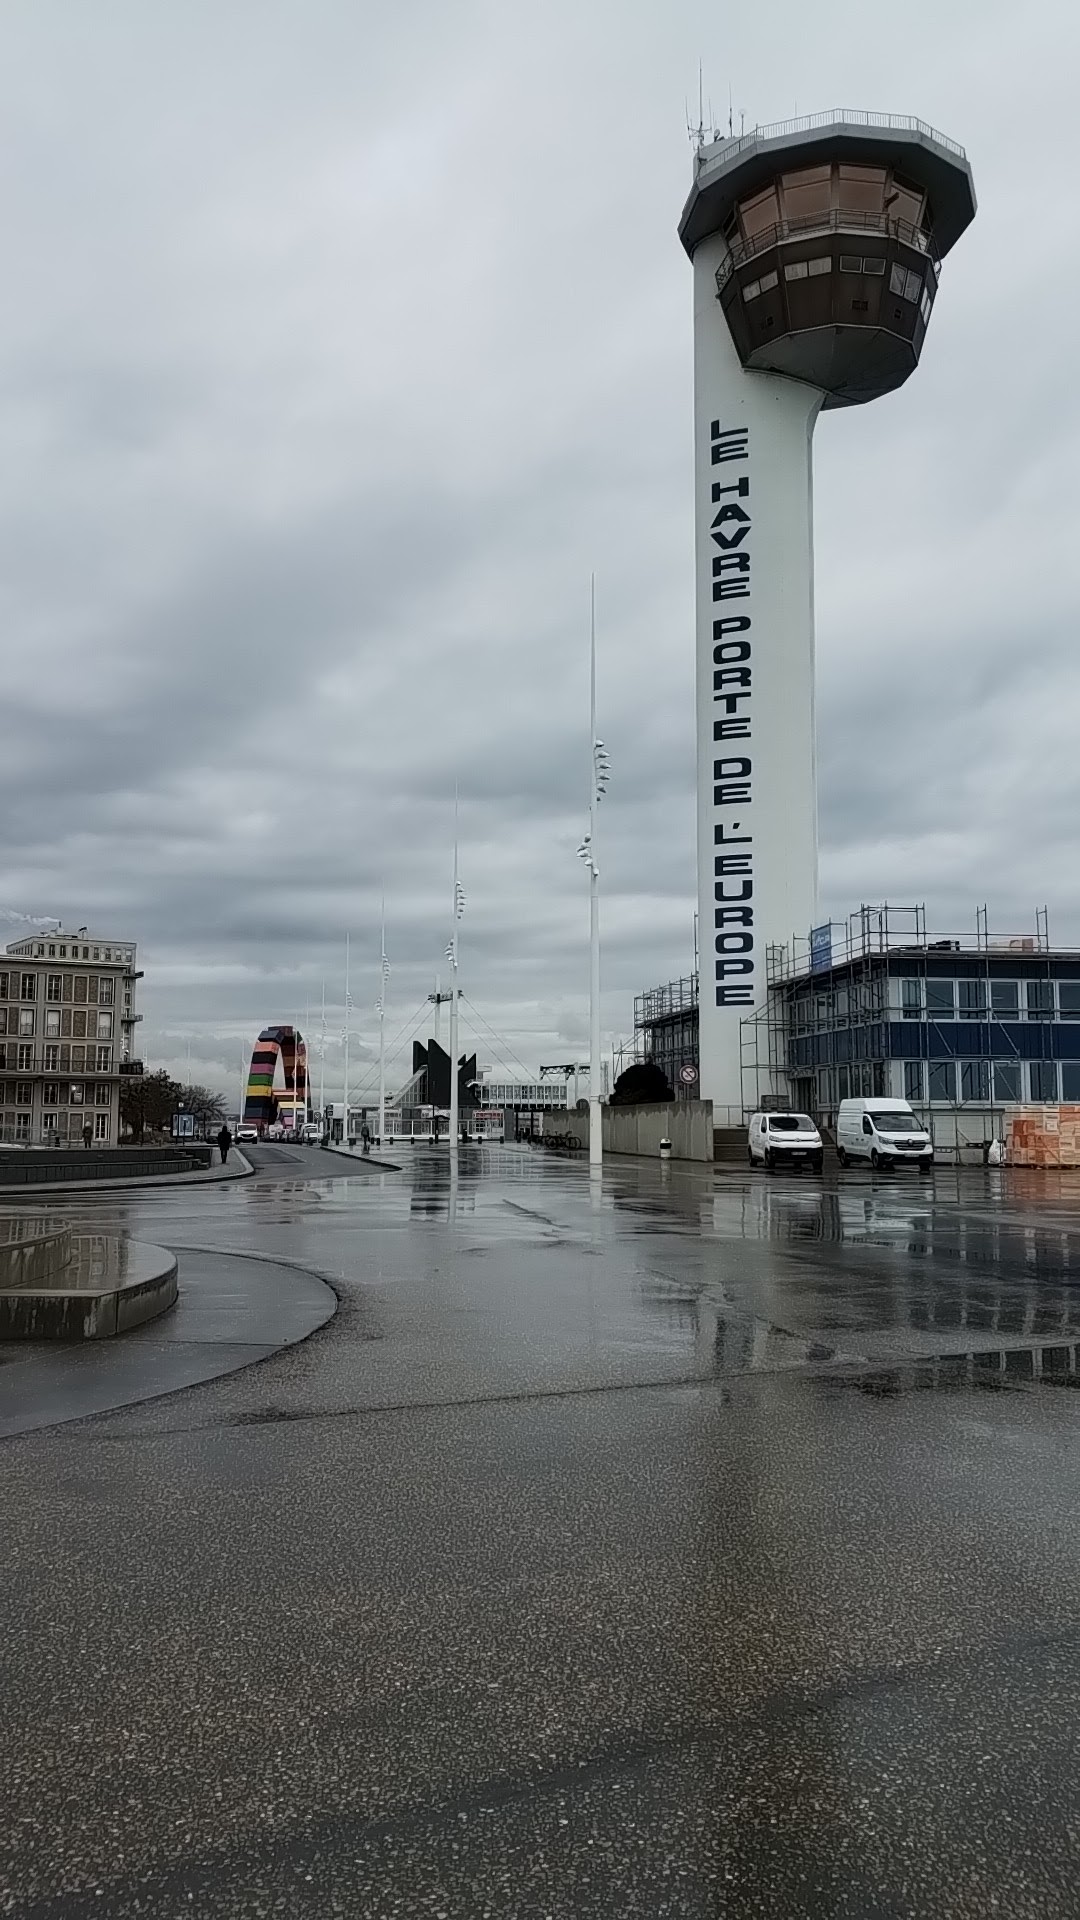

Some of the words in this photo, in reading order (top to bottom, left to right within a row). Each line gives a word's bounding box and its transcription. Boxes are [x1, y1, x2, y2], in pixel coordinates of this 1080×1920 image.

[710, 419, 749, 466] LE
[710, 476, 752, 602] HAVRE
[712, 615, 752, 741] PORTE
[713, 757, 752, 806] DE
[714, 822, 754, 1007] L'EUROPE
